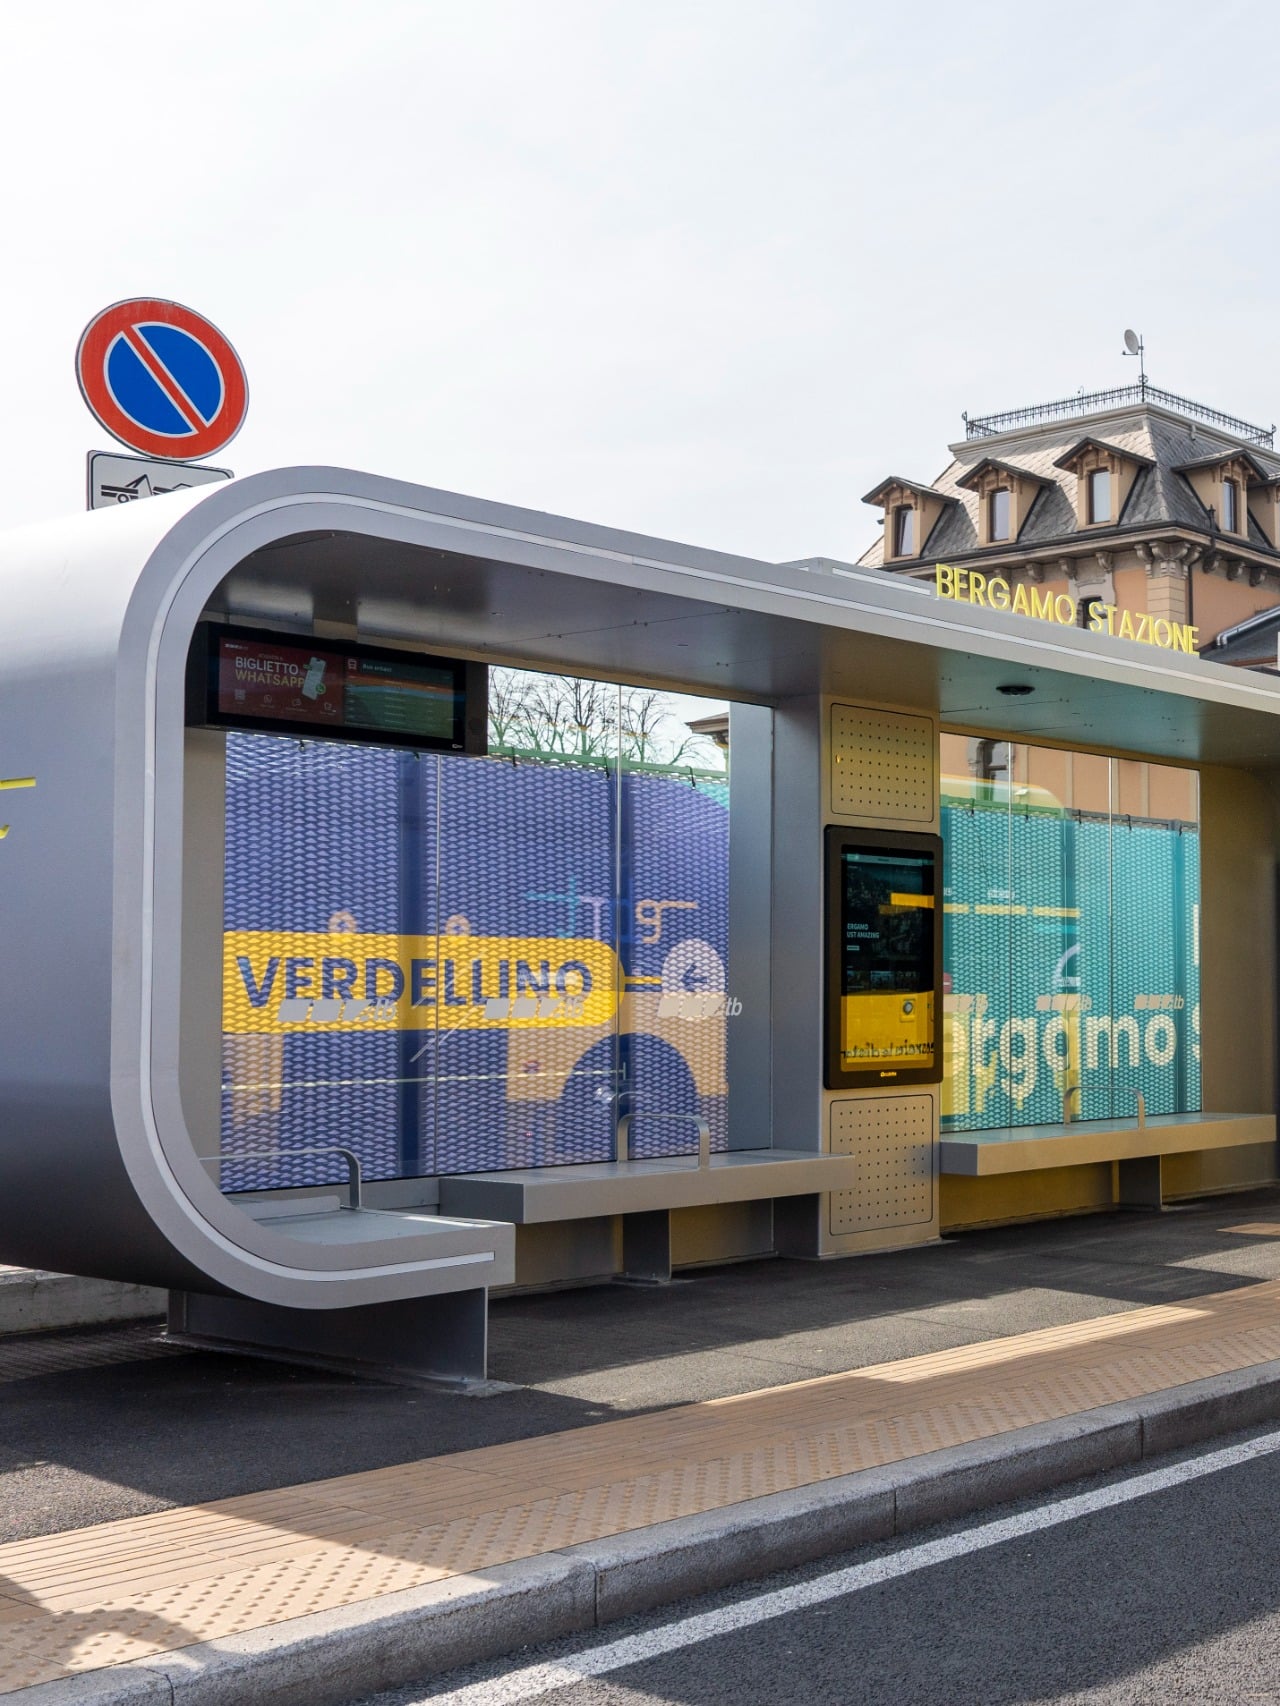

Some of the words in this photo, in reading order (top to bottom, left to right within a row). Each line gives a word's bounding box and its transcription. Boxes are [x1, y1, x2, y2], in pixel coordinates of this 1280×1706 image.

[936, 563, 1077, 626] BERGAMO
[1089, 601, 1199, 656] STAZIONE
[235, 656, 299, 675] BIGLIETTO
[235, 669, 305, 688] WHATSAPP
[236, 955, 594, 1008] VERDELLINO
